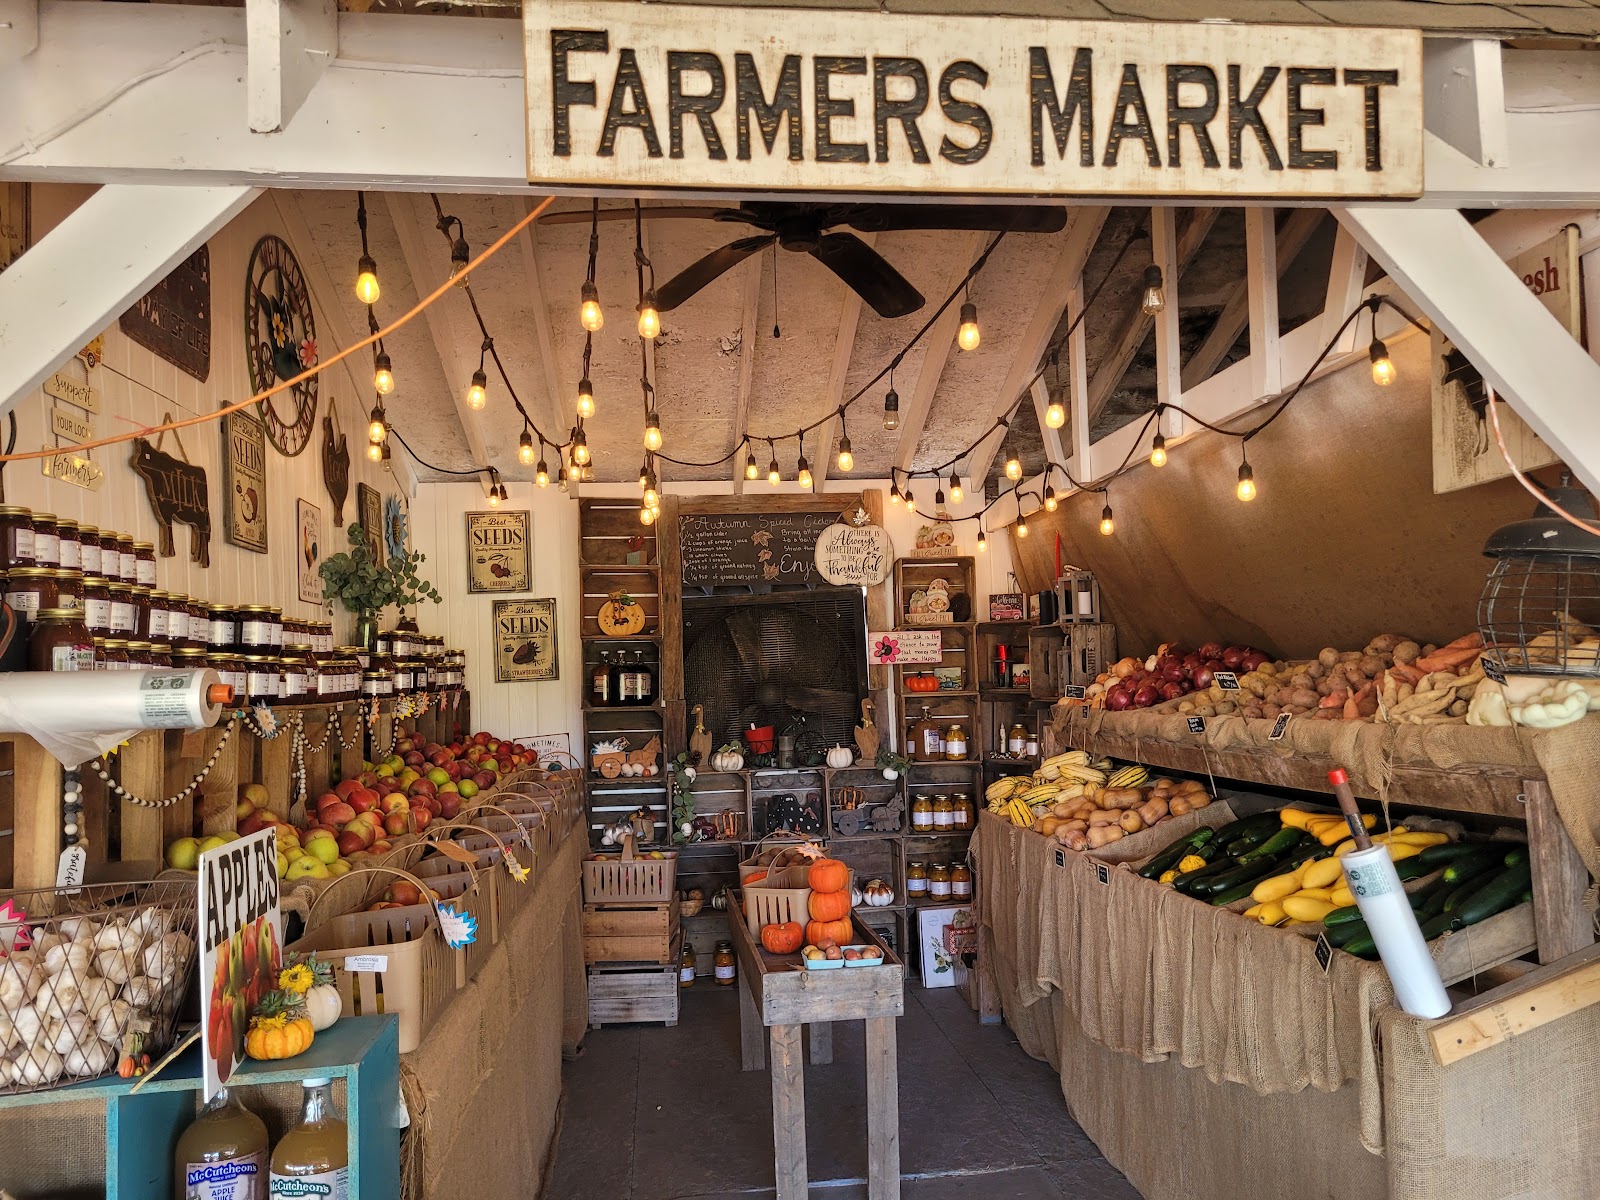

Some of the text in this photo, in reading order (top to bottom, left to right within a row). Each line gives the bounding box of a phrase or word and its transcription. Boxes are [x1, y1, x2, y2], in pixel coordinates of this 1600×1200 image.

[551, 29, 1399, 172] FARMERS MARKET
[53, 374, 94, 407] support
[55, 415, 73, 433] YOUR
[233, 435, 262, 473] SEEDS
[53, 455, 98, 487] farmers
[159, 468, 206, 513] MILK
[487, 517, 507, 526] Best
[694, 516, 751, 531] Autumn
[758, 515, 794, 532] Spiced
[473, 528, 522, 545] SEEDS
[831, 529, 878, 551] Always
[852, 529, 872, 537] THERE
[825, 544, 864, 555] SOMETHING
[823, 555, 884, 576] Thankful
[515, 606, 534, 614] Best
[500, 616, 549, 634] SEEDS
[511, 668, 544, 676] STRAWBERRIES
[205, 834, 278, 954] APPLES
[188, 1163, 258, 1184] McCutcheon's
[211, 1186, 236, 1198] APPLE
